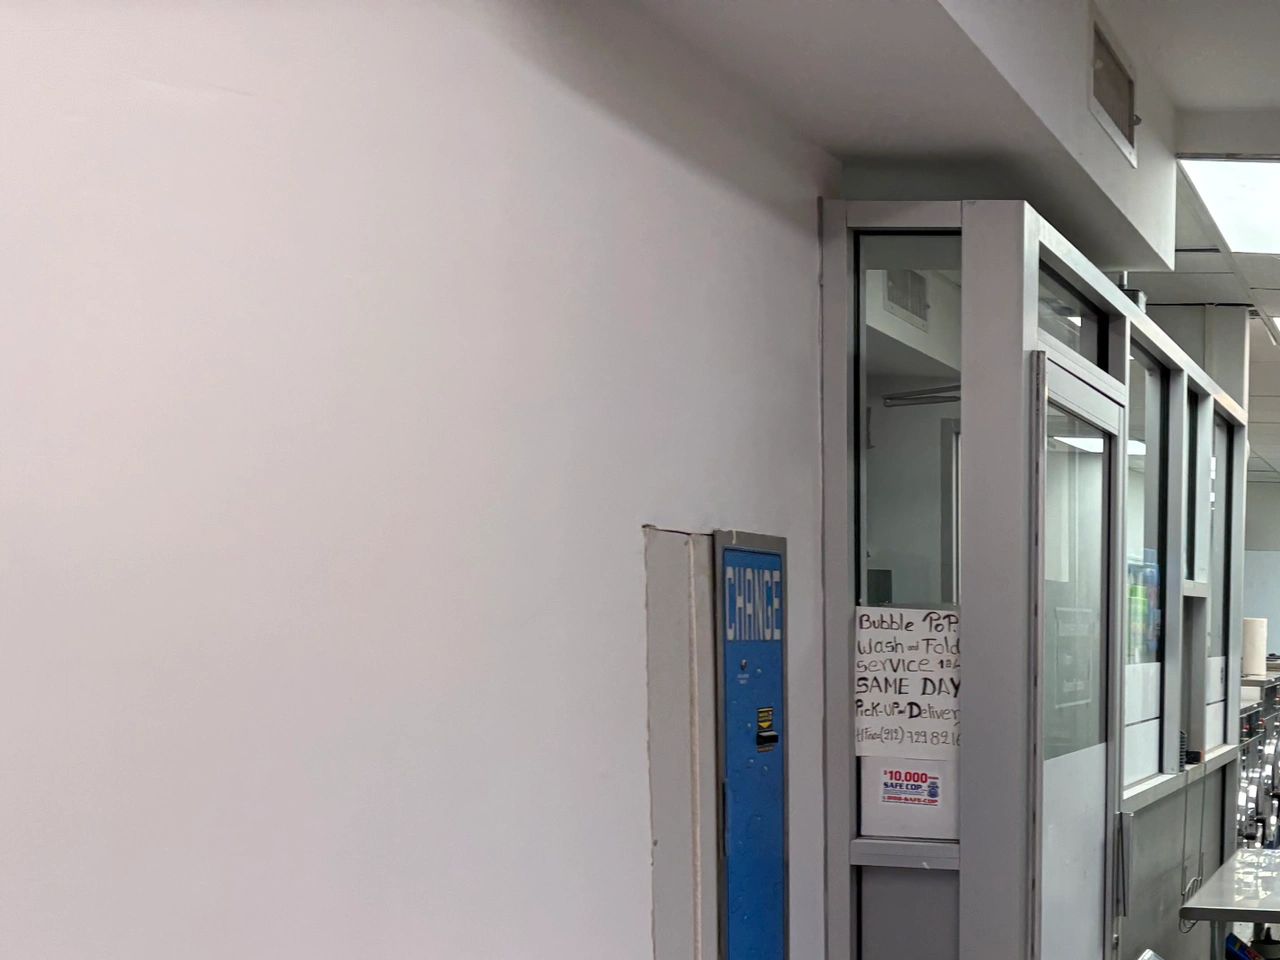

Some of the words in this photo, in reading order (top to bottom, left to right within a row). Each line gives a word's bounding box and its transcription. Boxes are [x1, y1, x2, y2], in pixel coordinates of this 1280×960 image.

[726, 566, 781, 640] CHANGE
[859, 613, 914, 631] Bubble
[921, 636, 960, 655] Fold
[856, 676, 909, 695] SAME
[921, 677, 960, 698] DAY
[907, 701, 960, 726] Deliver
